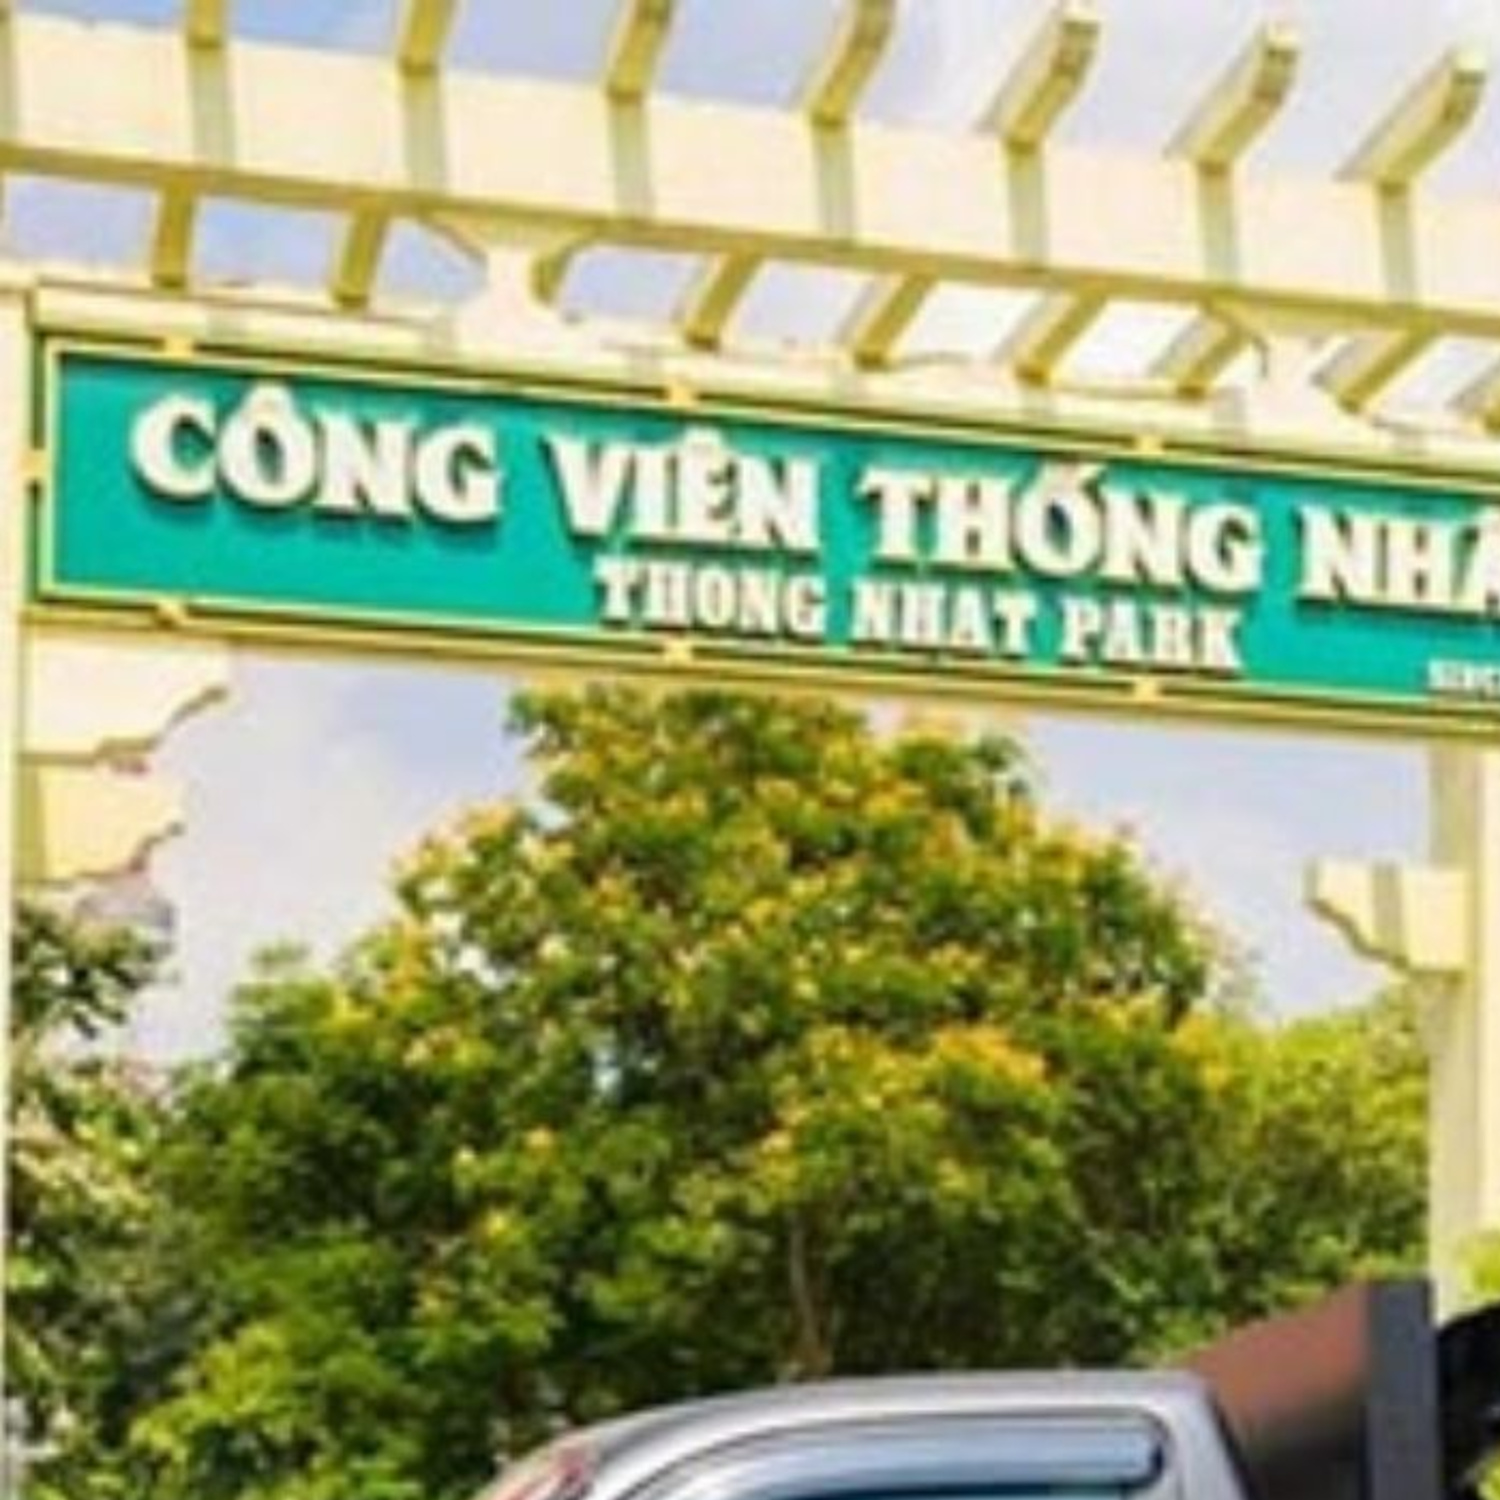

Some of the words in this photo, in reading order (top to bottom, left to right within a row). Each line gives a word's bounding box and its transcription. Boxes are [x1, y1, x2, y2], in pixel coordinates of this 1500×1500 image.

[130, 382, 502, 522] CÔNG
[547, 425, 822, 552] VIÊN
[857, 460, 1266, 592] THỐNG
[594, 553, 828, 636] THONG
[852, 578, 1035, 658] NHAT
[1060, 594, 1246, 672] PARK
